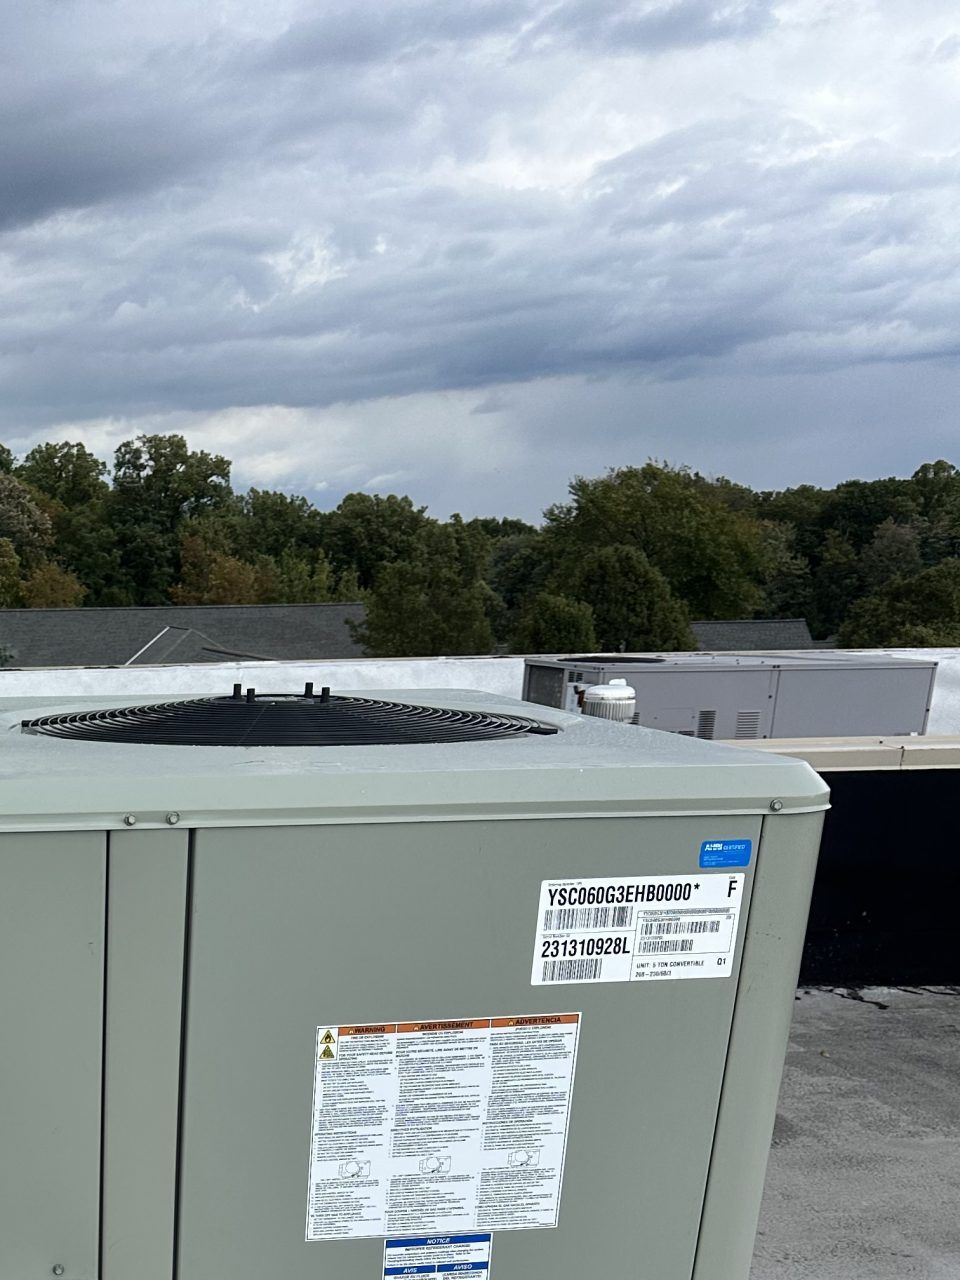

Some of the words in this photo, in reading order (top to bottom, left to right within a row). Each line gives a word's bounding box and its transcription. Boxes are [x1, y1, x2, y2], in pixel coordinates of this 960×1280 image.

[727, 880, 738, 898] F
[541, 936, 630, 958] 231310928L
[420, 1022, 474, 1030] AVERTISSEMENT
[515, 1017, 562, 1025] ADVERTENCIA
